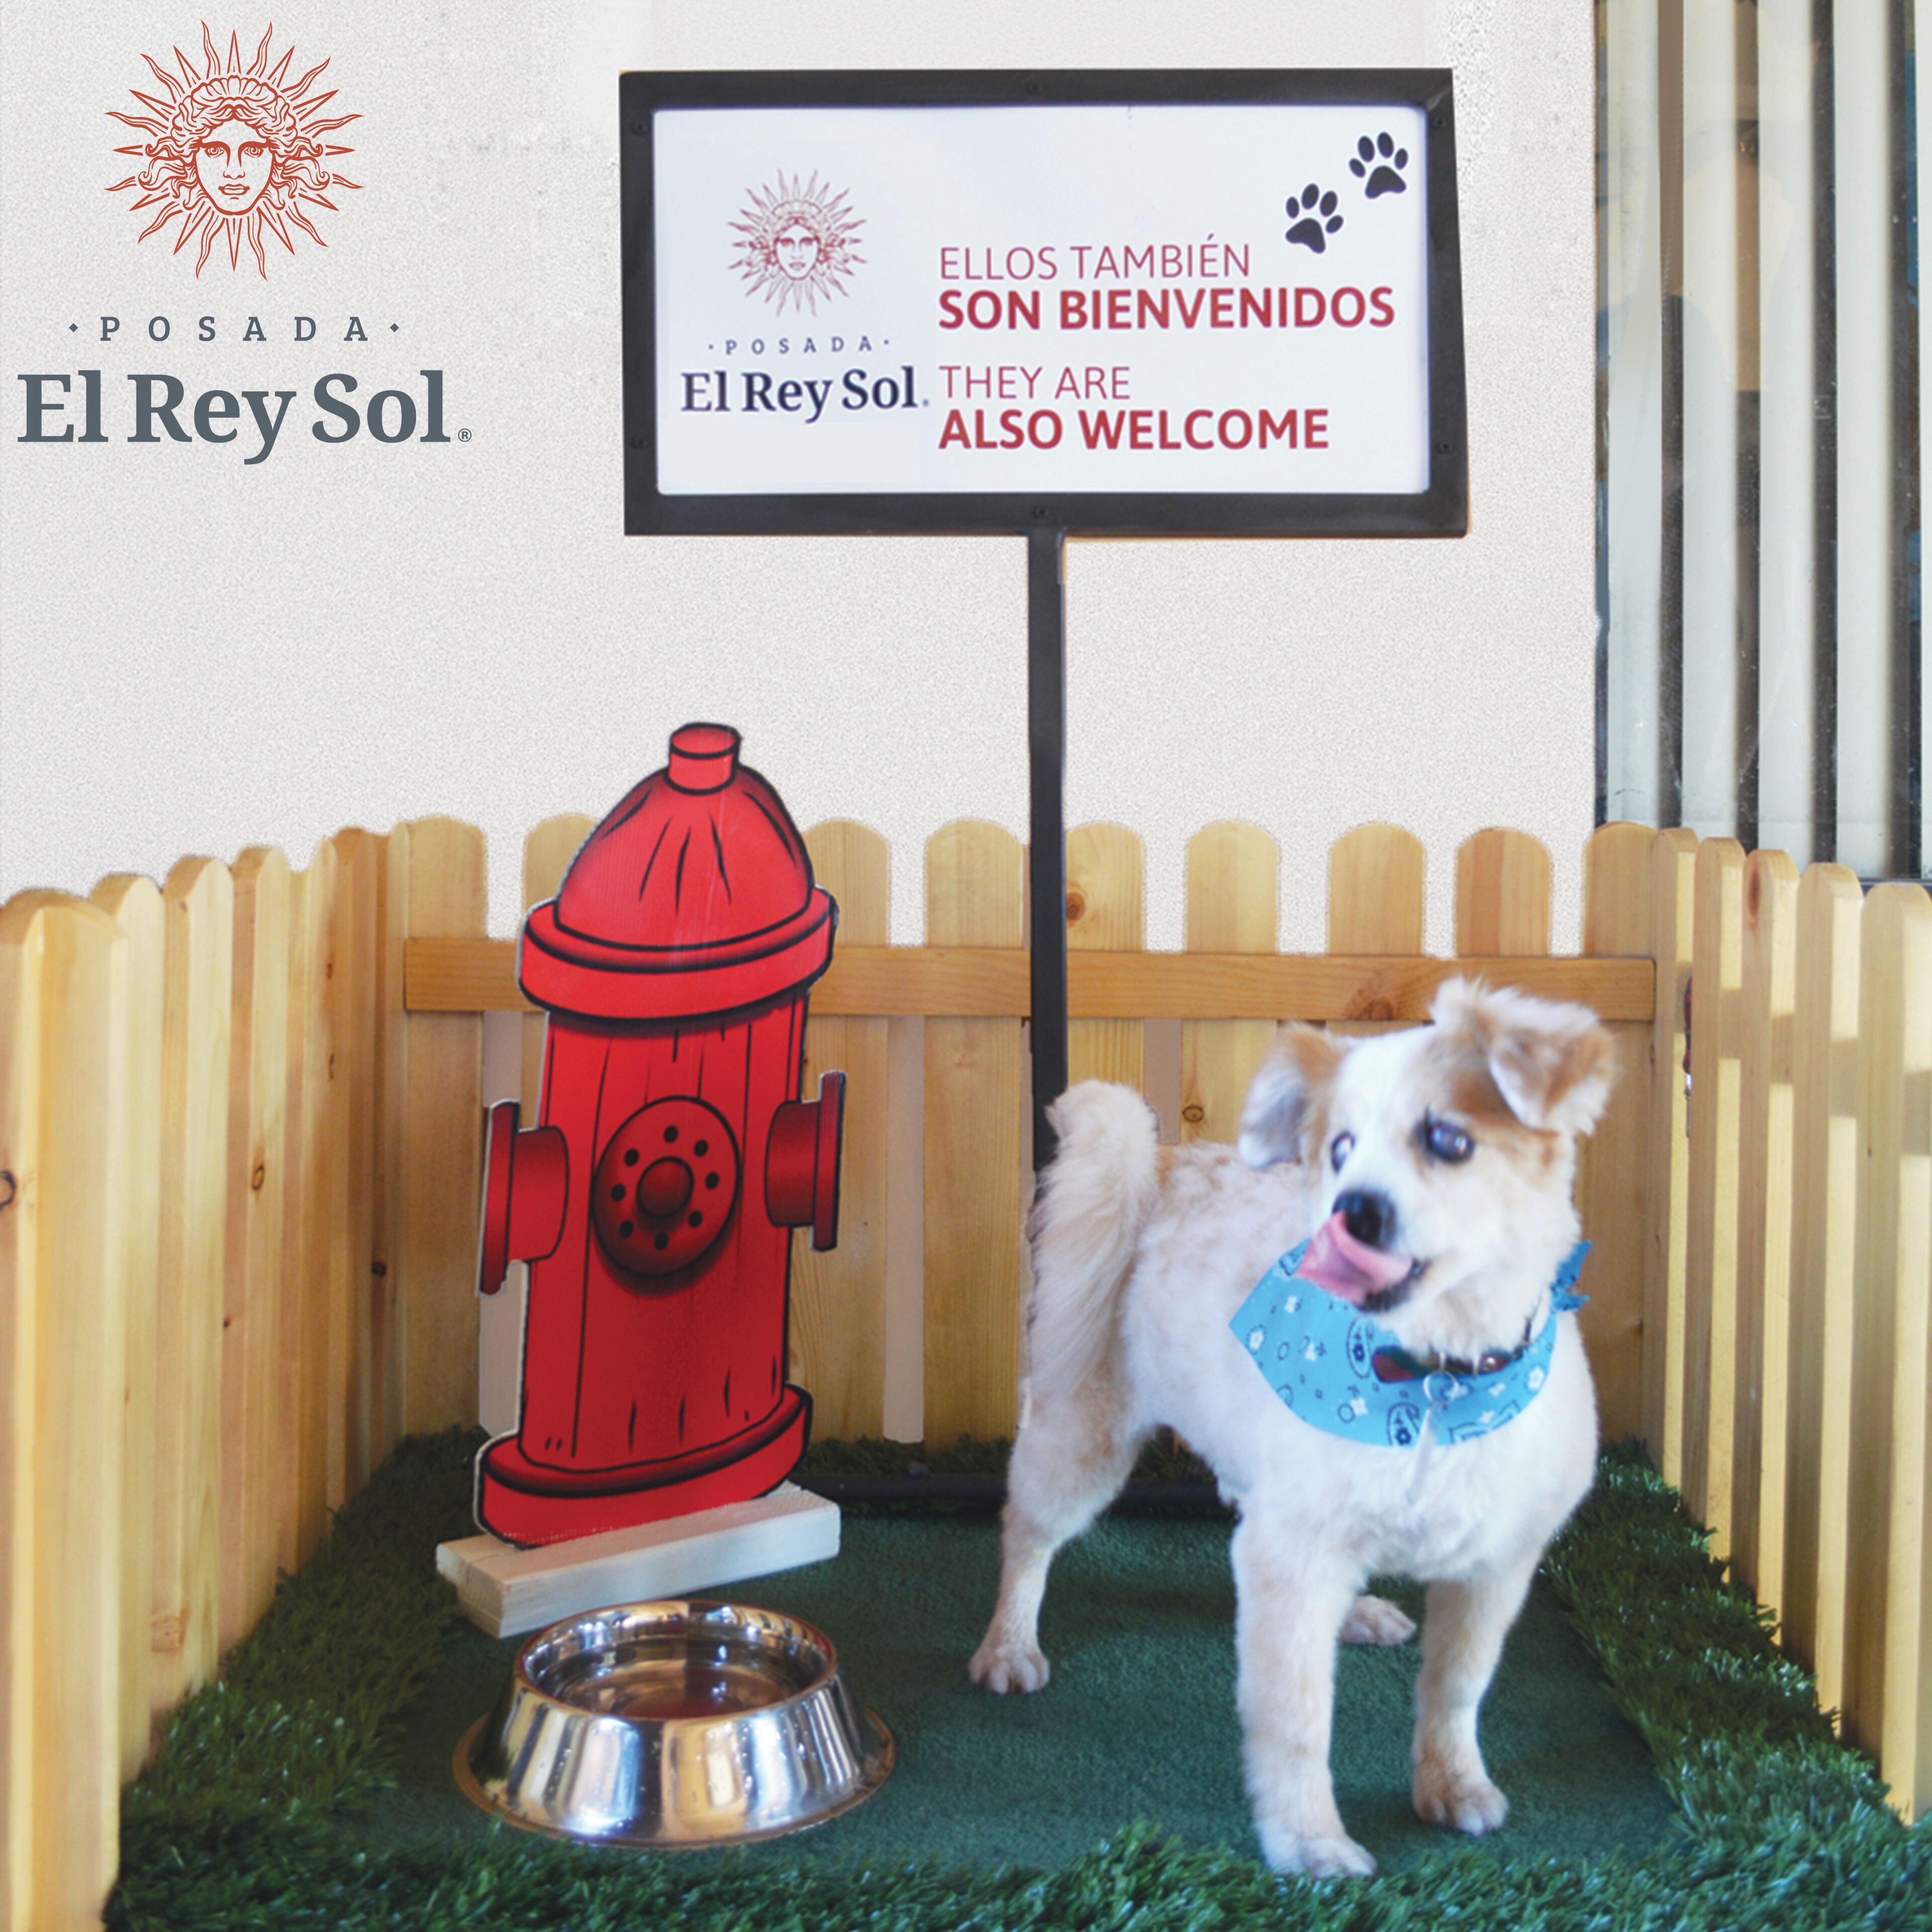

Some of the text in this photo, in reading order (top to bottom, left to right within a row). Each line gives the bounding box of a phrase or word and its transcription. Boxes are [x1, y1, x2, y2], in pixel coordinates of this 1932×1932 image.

[940, 233, 1250, 280] ELLOS TAMBIÉN
[938, 286, 1395, 330] SON BIENVENIDOS
[725, 336, 872, 355] POSADA
[681, 370, 731, 412] El
[741, 372, 834, 424] Rey
[938, 365, 1131, 400] THEY ARE
[938, 409, 1329, 450] ALSO WELCOME
